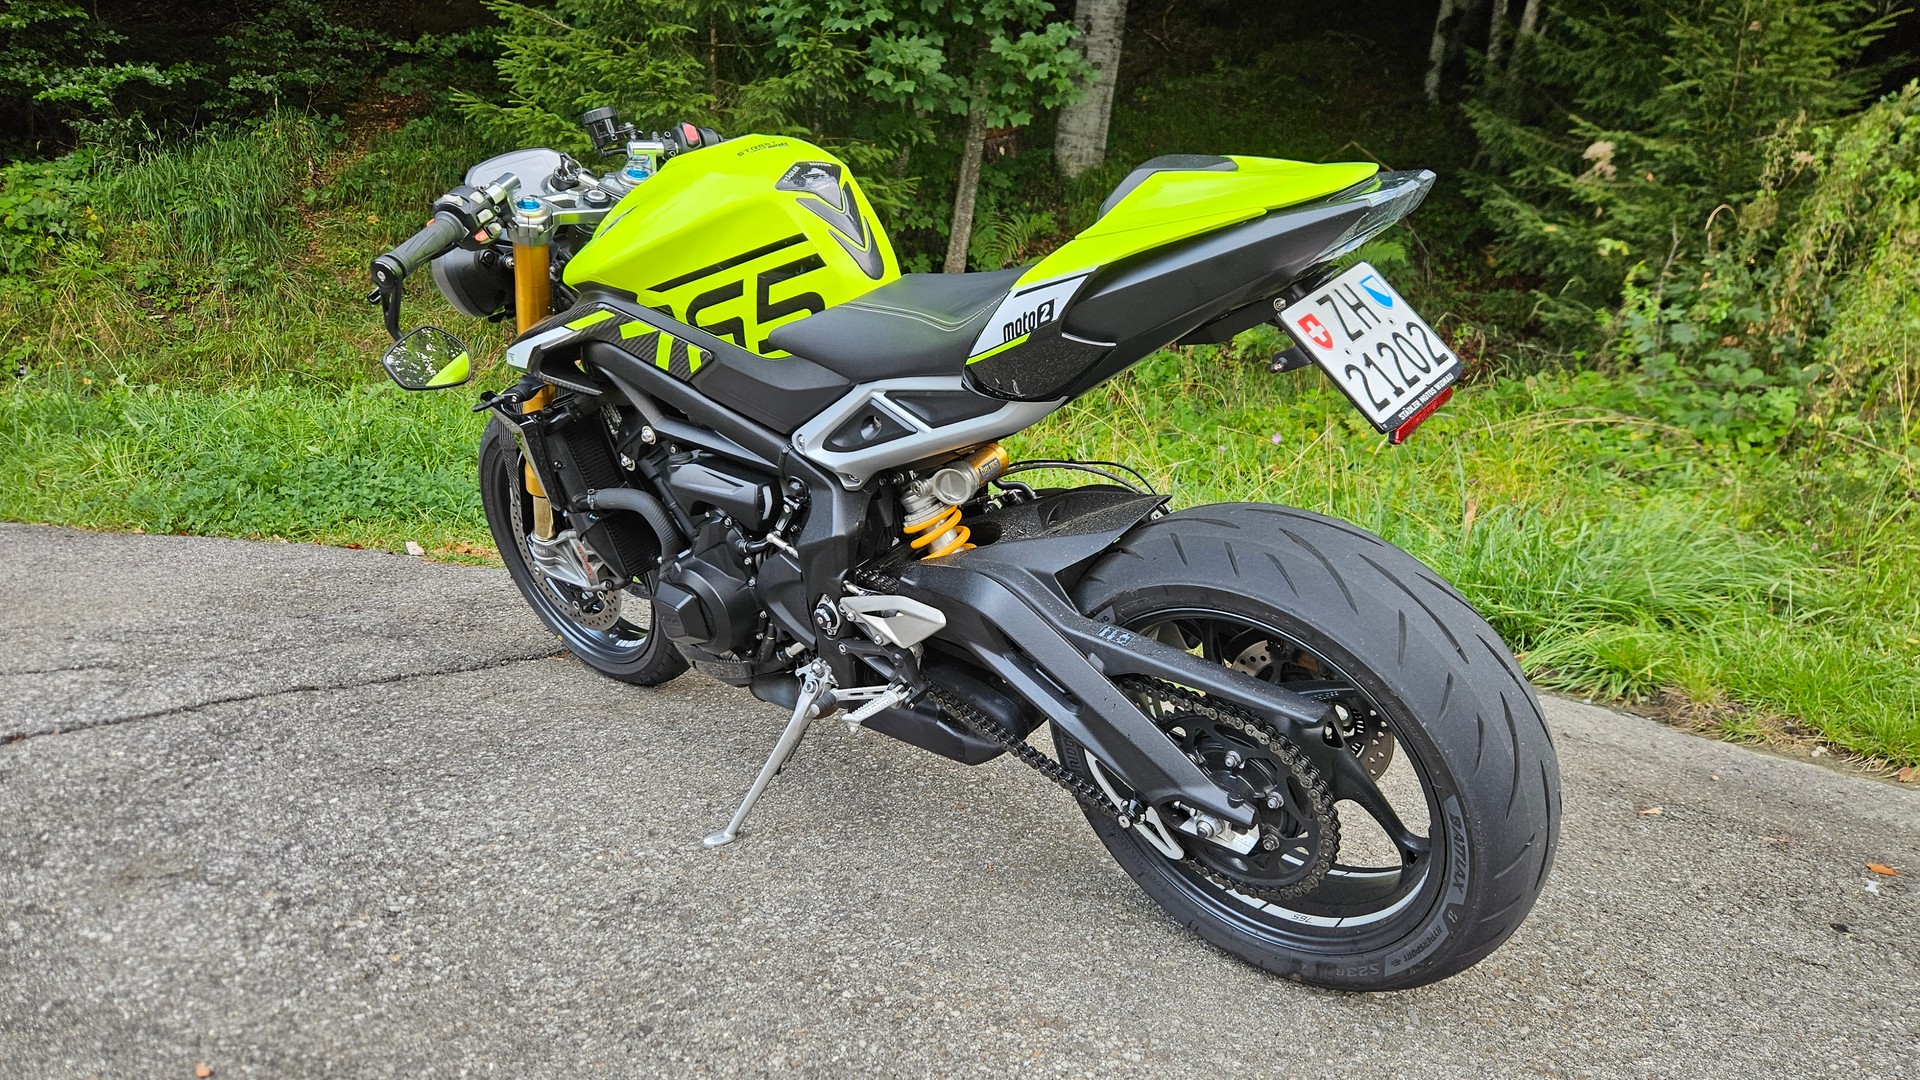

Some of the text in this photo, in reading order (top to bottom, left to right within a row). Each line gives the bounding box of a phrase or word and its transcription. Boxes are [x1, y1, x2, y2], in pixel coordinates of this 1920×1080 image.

[1315, 283, 1381, 342] ZH
[1344, 321, 1449, 412] 21202
[1398, 400, 1423, 420] STÄDLER
[1420, 387, 1437, 406] MOTOS
[1449, 814, 1468, 895] BATTLAX
[1291, 913, 1312, 924] 765
[1403, 924, 1443, 962] HYPERSPORT
